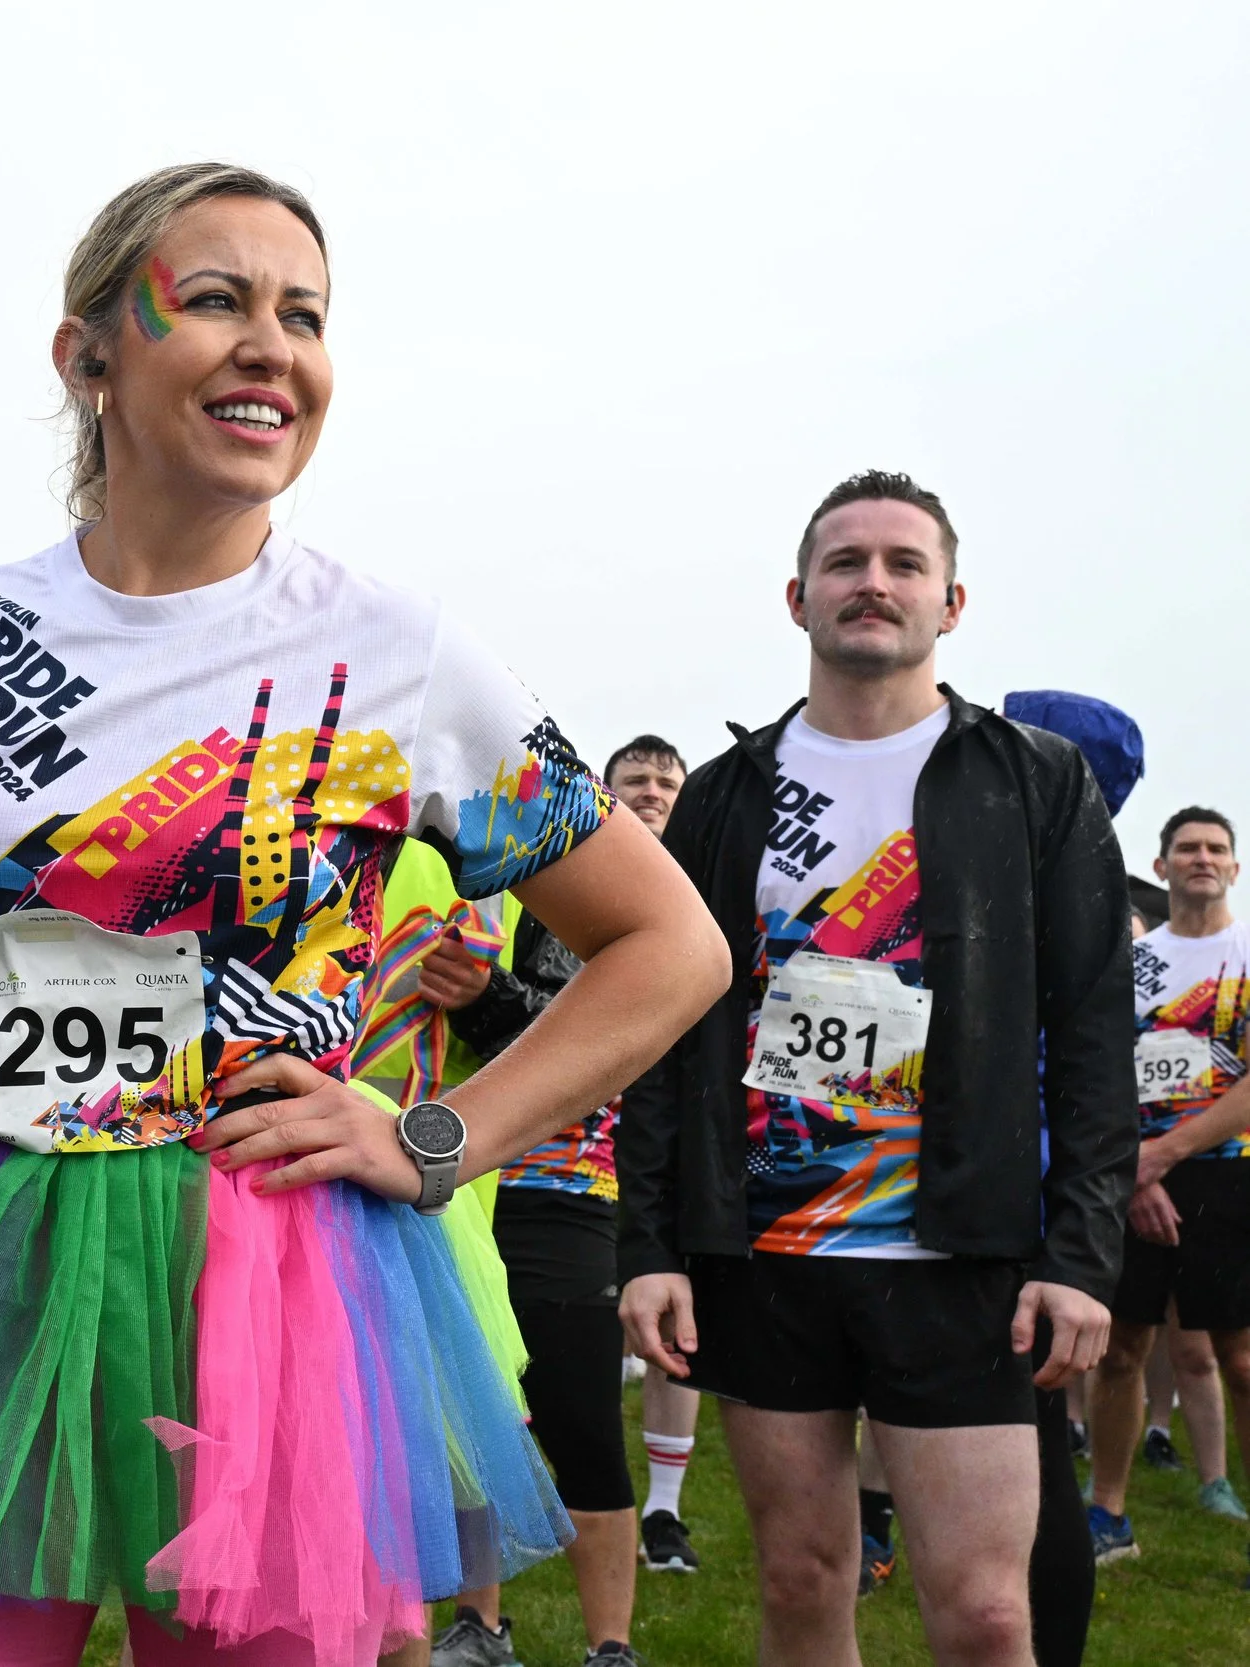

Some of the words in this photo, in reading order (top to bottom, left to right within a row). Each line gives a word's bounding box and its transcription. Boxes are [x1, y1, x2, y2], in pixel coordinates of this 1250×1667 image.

[90, 726, 242, 856] PRIDE
[769, 808, 837, 871] UN
[770, 857, 807, 882] 2024
[849, 825, 917, 912] PRID
[0, 981, 27, 993] Origin
[44, 978, 91, 986] ARTHUR
[93, 977, 117, 986] COX
[135, 973, 189, 987] QUANTA
[786, 1012, 878, 1068] 381
[759, 1053, 792, 1068] PRIDE
[772, 1066, 798, 1080] RUN
[1143, 1058, 1190, 1083] 592
